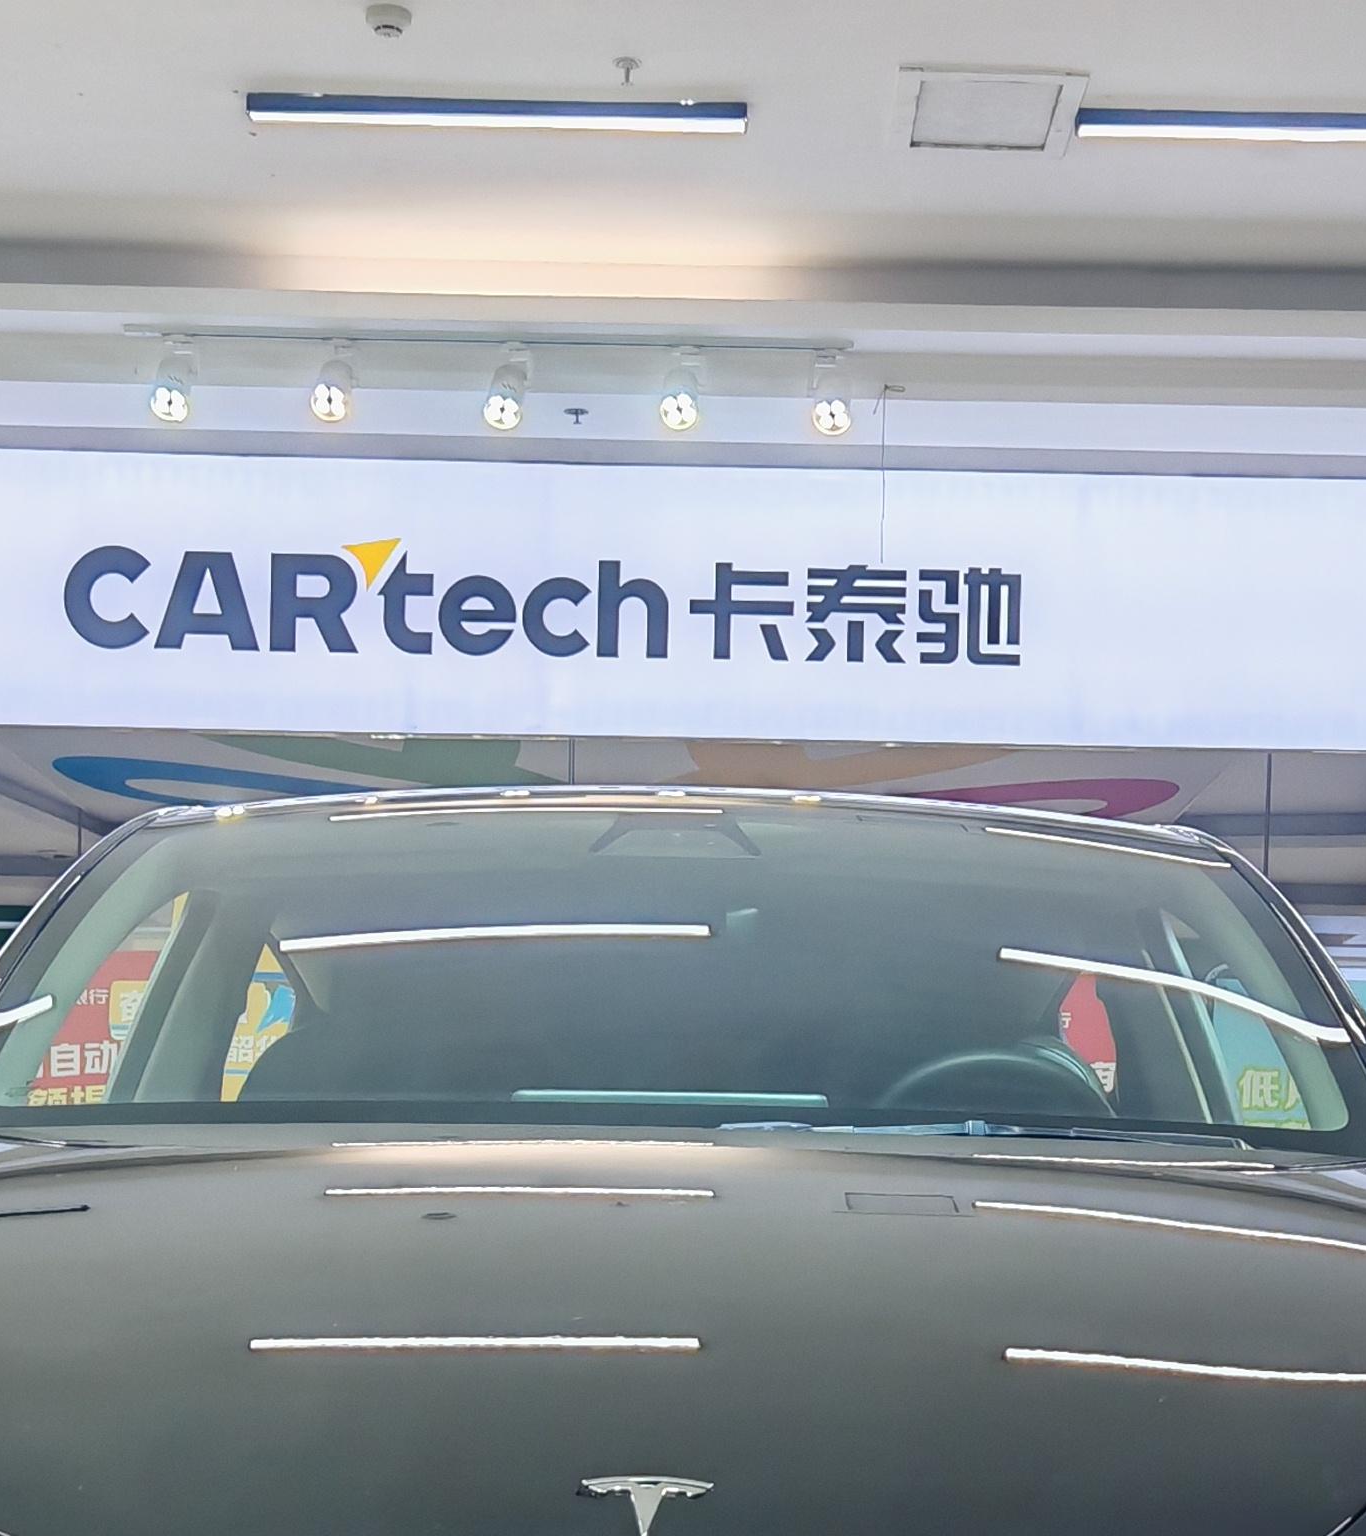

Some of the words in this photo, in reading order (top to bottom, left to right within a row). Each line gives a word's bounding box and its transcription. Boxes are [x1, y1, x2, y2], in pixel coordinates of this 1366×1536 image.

[63, 544, 669, 660] CARtech
[690, 562, 1022, 667] 卡泰驰
